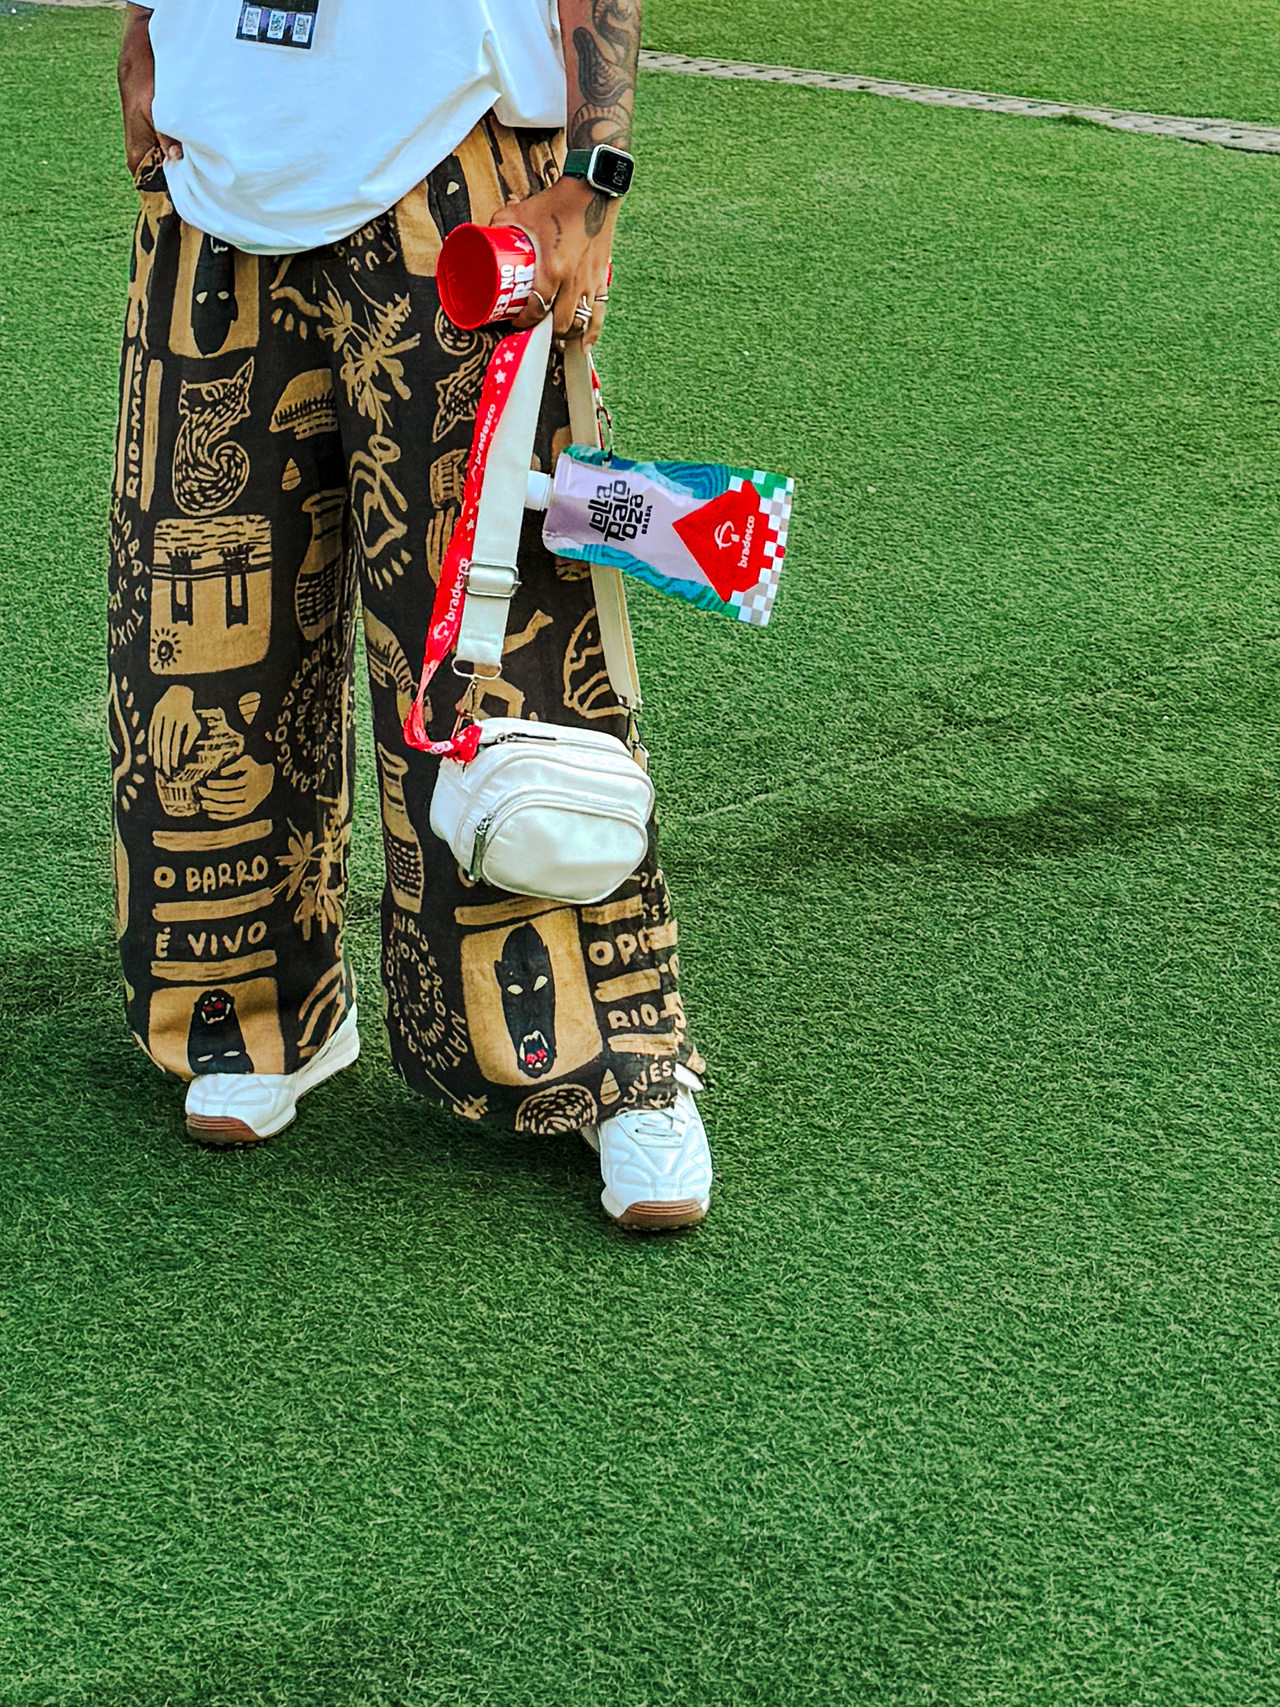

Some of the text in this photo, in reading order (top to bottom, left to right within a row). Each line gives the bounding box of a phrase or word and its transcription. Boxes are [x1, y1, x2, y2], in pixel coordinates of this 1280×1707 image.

[475, 403, 497, 466] bradesco
[737, 515, 756, 569] bradesco
[445, 556, 469, 623] bradesco
[153, 854, 269, 894] O BARRO
[155, 920, 268, 958] É VIVO
